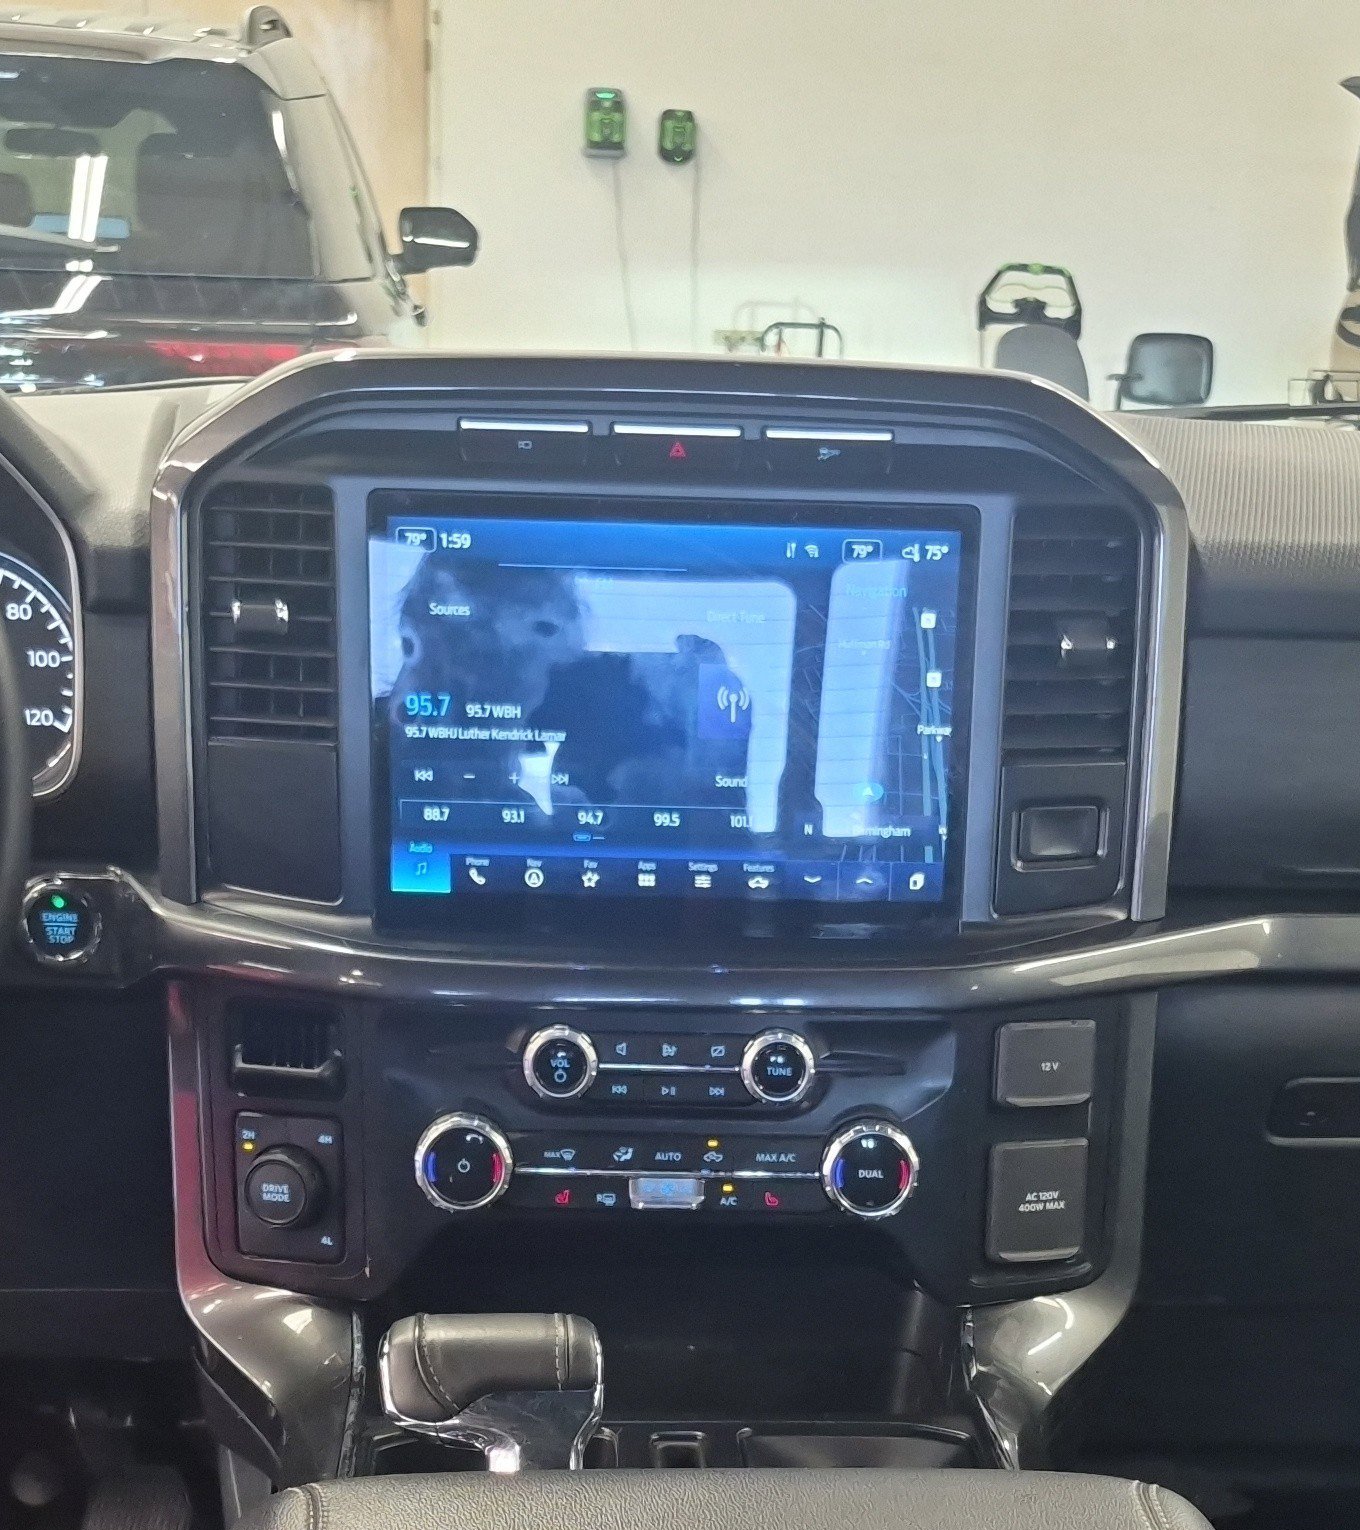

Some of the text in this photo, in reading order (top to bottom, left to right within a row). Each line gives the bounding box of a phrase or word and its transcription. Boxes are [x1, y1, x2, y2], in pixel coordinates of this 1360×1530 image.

[440, 532, 472, 549] 1:59
[5, 603, 33, 621] 80
[429, 602, 471, 616] Sources
[26, 650, 61, 668] 100
[405, 692, 452, 717] 95.7
[24, 708, 54, 726] 120
[465, 703, 522, 719] 95.7 WBH
[405, 726, 567, 742] 95.7 WBHJ Luther Kendrick Lamar
[715, 775, 749, 788] Sound
[423, 806, 451, 821] 88.7
[501, 808, 526, 824] 93.1
[577, 810, 604, 826] 94.7
[653, 812, 681, 827] 99.5
[804, 823, 813, 836] N
[42, 911, 78, 922] ENGINE
[45, 925, 77, 936] START
[48, 935, 75, 945] STOP
[550, 1058, 571, 1068] VOL
[1040, 1062, 1052, 1072] 12
[766, 1066, 793, 1077] TUNE
[241, 1129, 255, 1140] 2H
[654, 1151, 682, 1162] AUTO
[755, 1152, 797, 1163] MAX A/C
[857, 1169, 884, 1179] DUAL
[262, 1182, 290, 1194] DRIVE
[262, 1193, 291, 1203] MODE
[719, 1196, 739, 1206] A/C
[1025, 1190, 1060, 1202] AC 120V
[1018, 1200, 1066, 1213] 400W MAX
[320, 1235, 334, 1246] 4L
